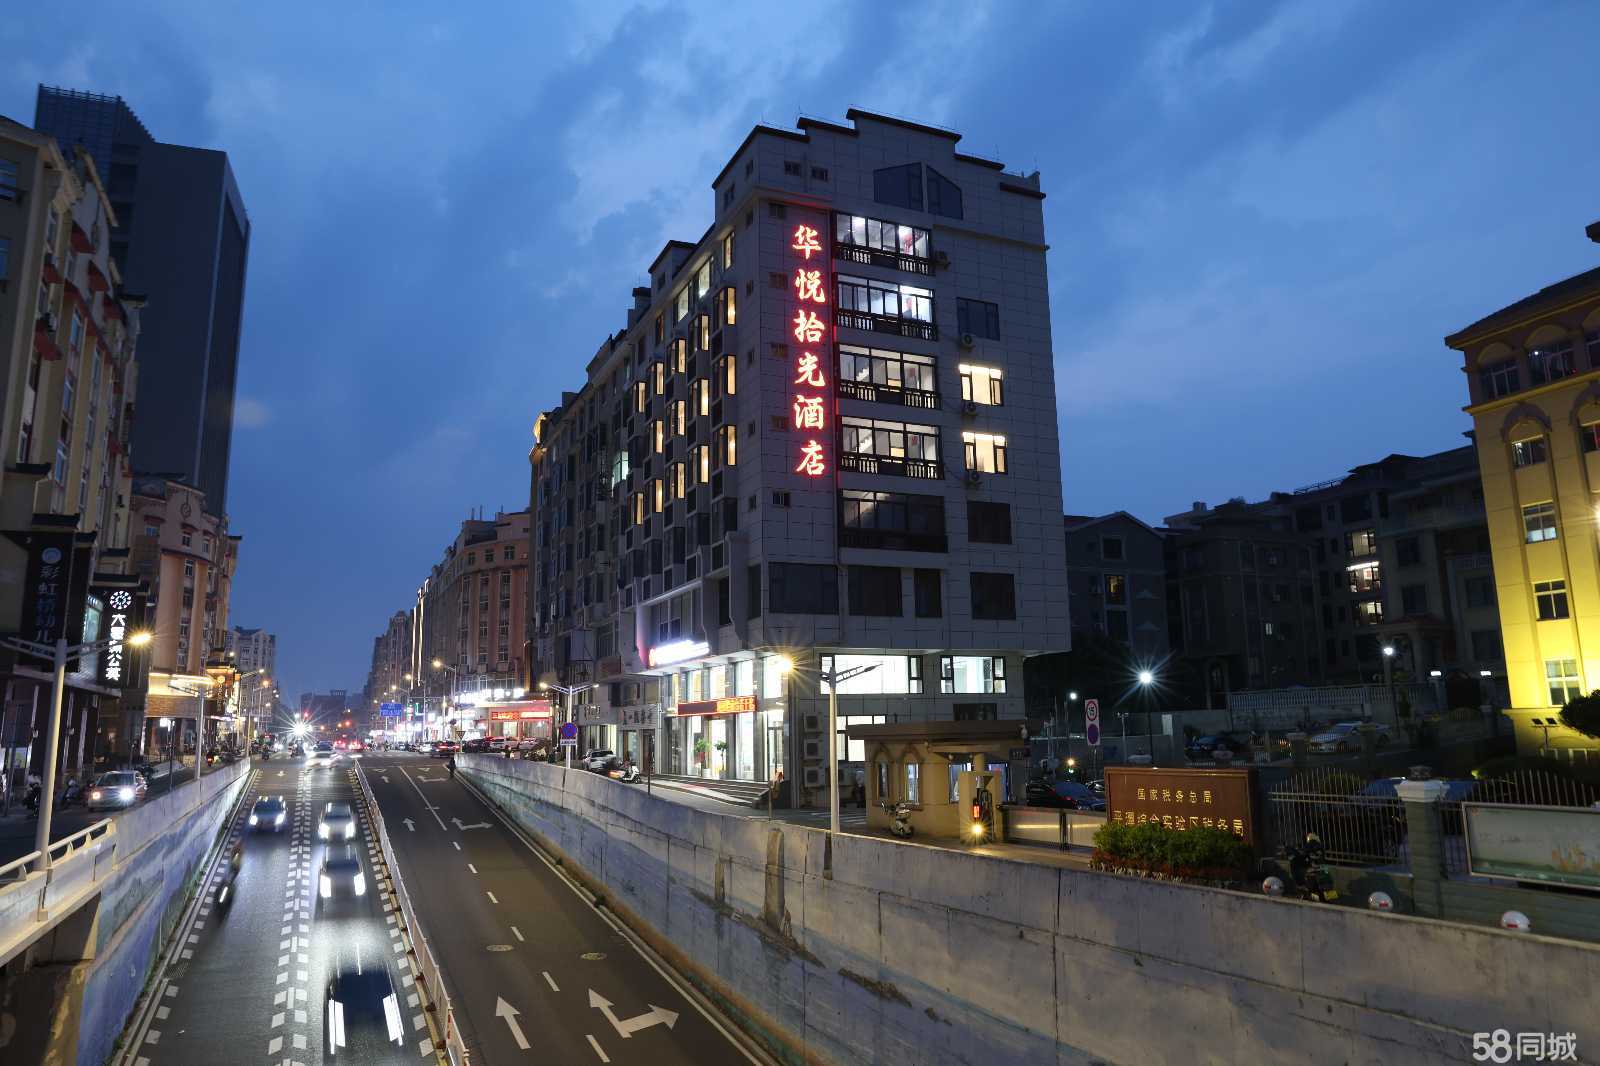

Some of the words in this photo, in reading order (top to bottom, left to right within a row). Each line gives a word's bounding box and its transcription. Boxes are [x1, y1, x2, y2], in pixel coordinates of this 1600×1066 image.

[792, 225, 825, 476] 华悦拾光酒店
[1136, 788, 1213, 804] 国家税务总局
